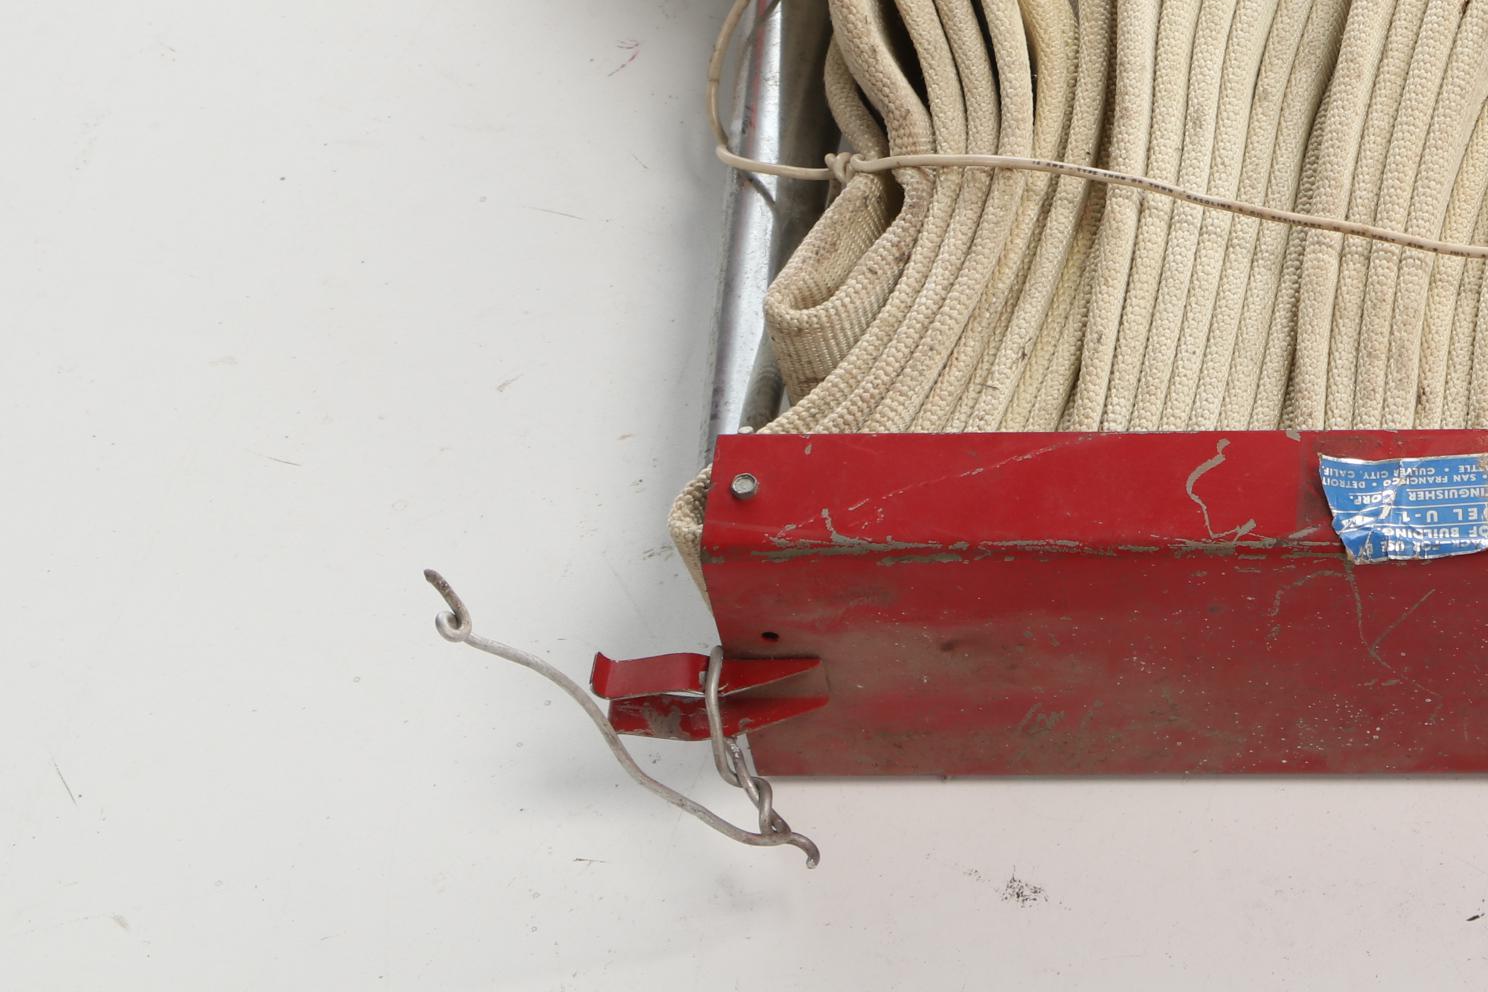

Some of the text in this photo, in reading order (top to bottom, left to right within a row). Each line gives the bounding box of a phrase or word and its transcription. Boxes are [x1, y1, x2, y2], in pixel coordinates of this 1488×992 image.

[1185, 194, 1233, 210] GASOLINE
[1393, 467, 1435, 476] CULVER
[1453, 473, 1476, 482] SAN
[1322, 477, 1366, 489] DETROIT
[1383, 475, 1448, 488] FRANCISCO
